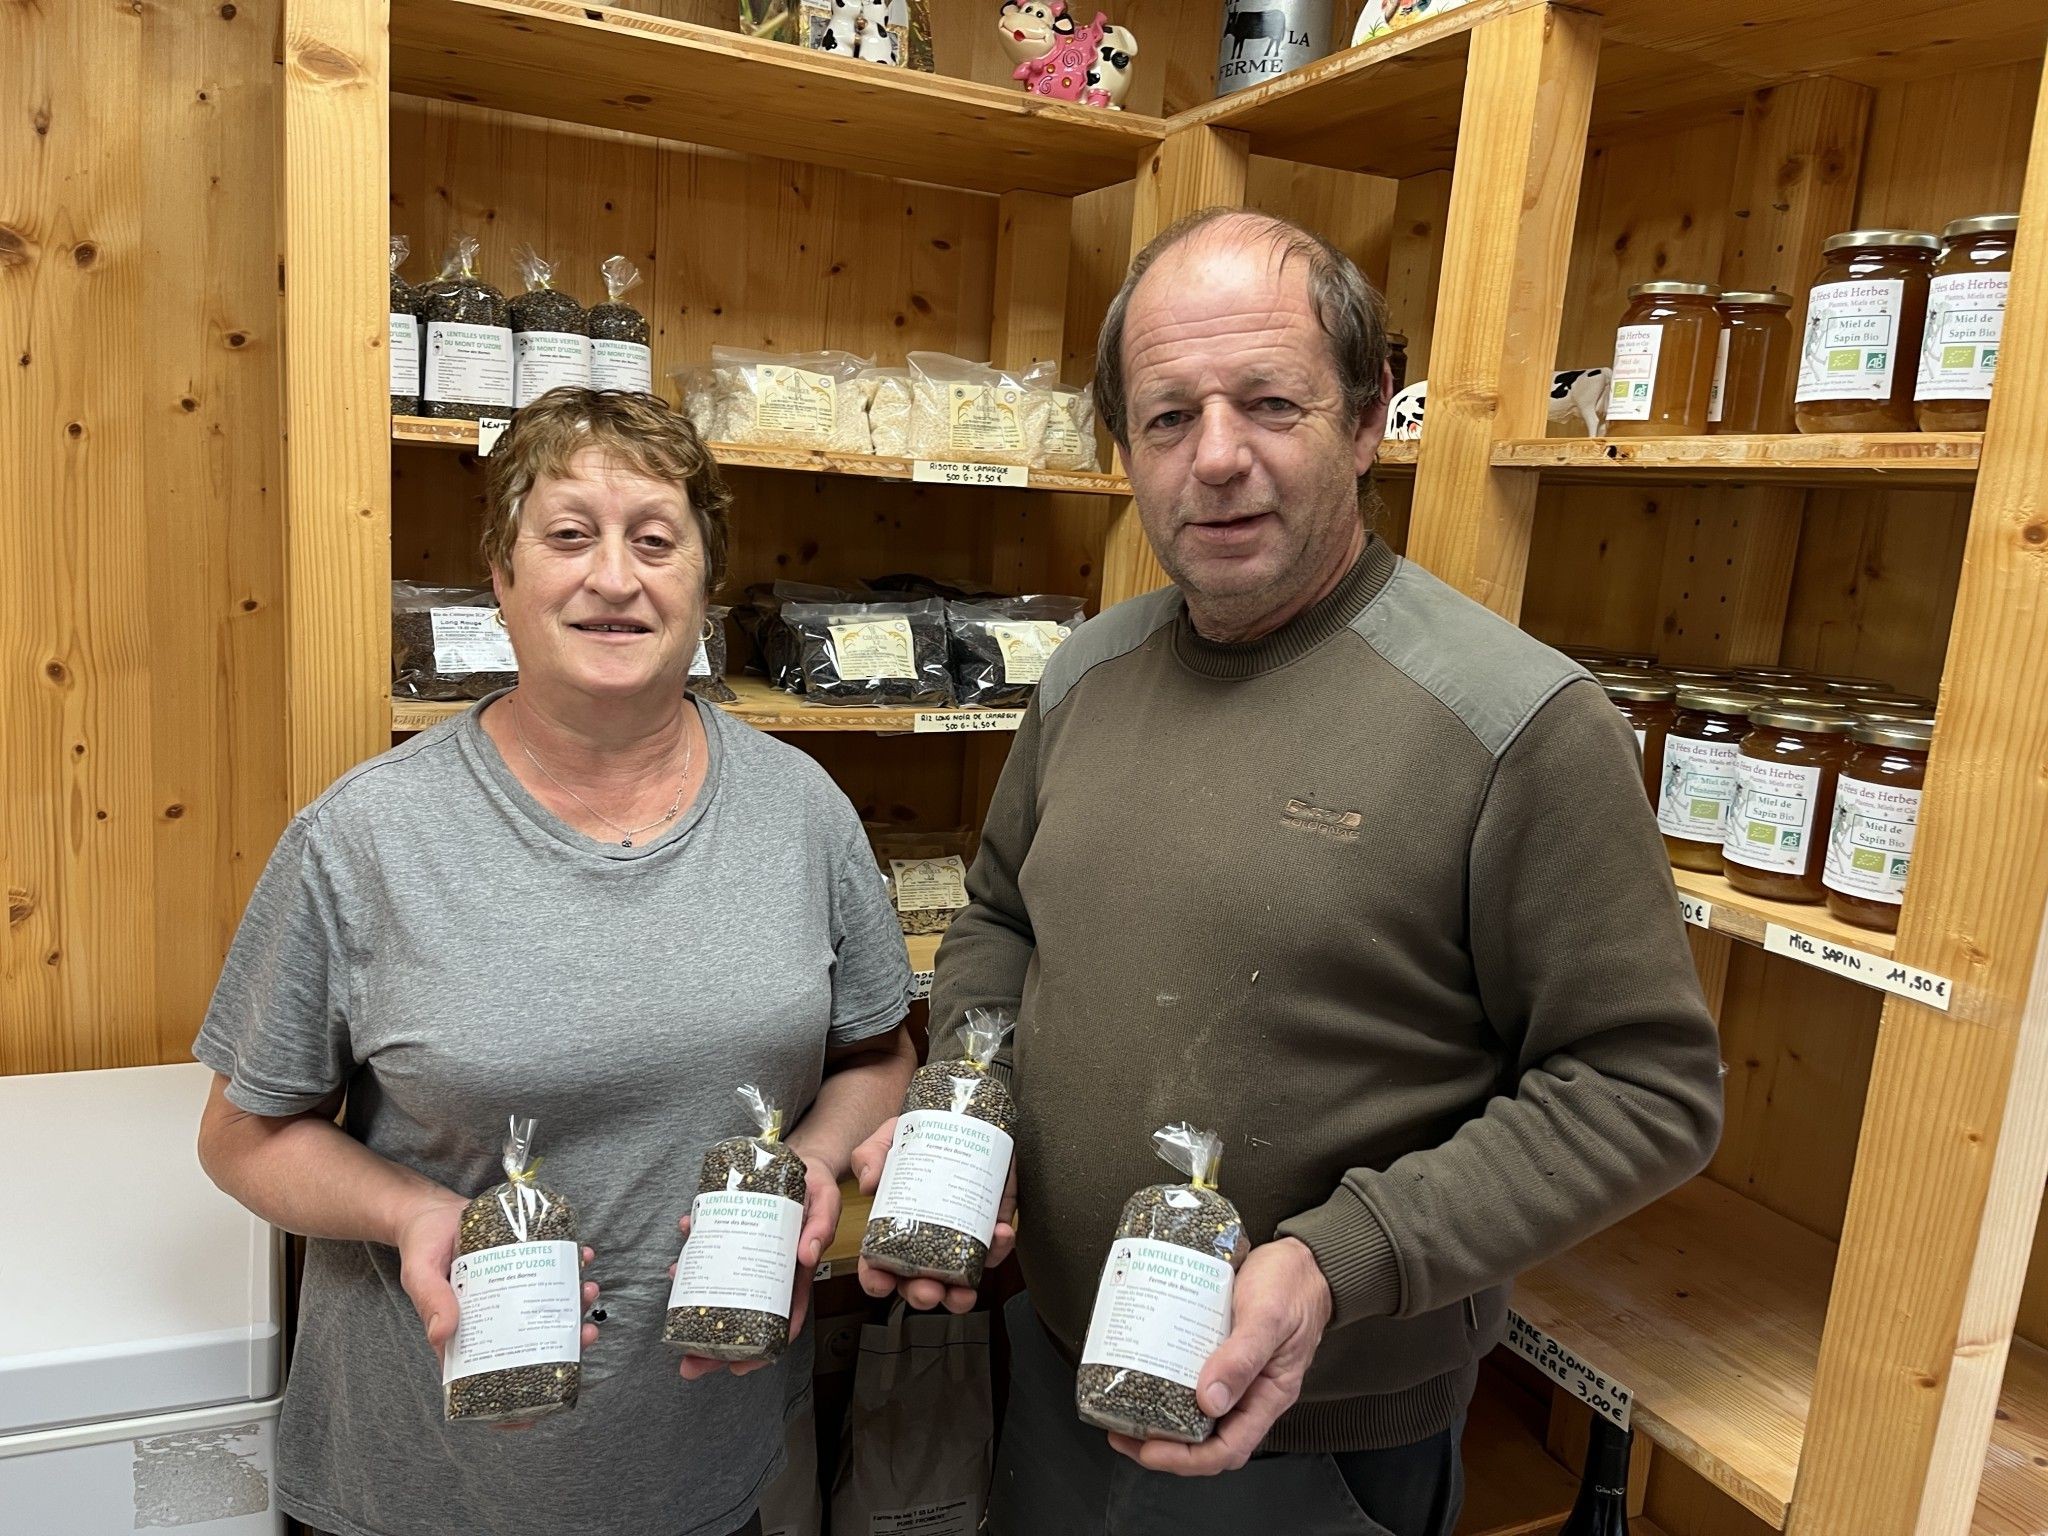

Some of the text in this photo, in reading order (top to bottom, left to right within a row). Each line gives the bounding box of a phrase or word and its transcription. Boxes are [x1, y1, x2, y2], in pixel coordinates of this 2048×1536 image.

[1288, 30, 1310, 47] LA
[1949, 278, 1965, 290] des
[1966, 278, 2009, 290] Herbes
[1833, 288, 1848, 298] des
[1850, 286, 1889, 298] Herbes
[1838, 319, 1876, 329] Miel de
[1954, 314, 1994, 324] Miel de
[1625, 331, 1651, 340] Herbes
[1833, 332, 1880, 344] Sapin Bio
[1949, 328, 1996, 340] Sapin Bio
[929, 462, 1009, 475] RISOTO DE CAMARGUE
[946, 473, 961, 482] 500
[945, 723, 958, 731] 500
[1692, 745, 1708, 756] des
[1753, 764, 1806, 781] des Herbes
[1700, 777, 1730, 786] Miel de
[1758, 797, 1792, 809] Miel de
[1859, 787, 1876, 800] des
[1877, 791, 1918, 806] Herbes
[1753, 807, 1795, 821] Sapin Bio
[1865, 821, 1903, 835] Miel de
[1858, 833, 1905, 848] Sapin Bio
[1822, 945, 1862, 970] SAPIN
[917, 1119, 991, 1143] LENTILLES VERTES
[925, 1132, 954, 1143] MONT
[954, 1137, 992, 1157] D'UZORE
[705, 1195, 778, 1208] LENTILLES VERTES
[700, 1208, 780, 1222] DU MONT D'UZORE
[473, 1245, 553, 1265] LENTILLES VERTES
[470, 1258, 557, 1279] DU MONT D'UZORE
[1138, 1247, 1220, 1278] LENTILLES VERTES
[507, 1273, 517, 1281] des
[1131, 1261, 1223, 1295] DU MONT D'UZORE
[1148, 1275, 1168, 1288] Ferme
[1168, 1280, 1179, 1290] des
[1546, 1338, 1606, 1390] BLONDE
[1610, 1385, 1629, 1405] LA
